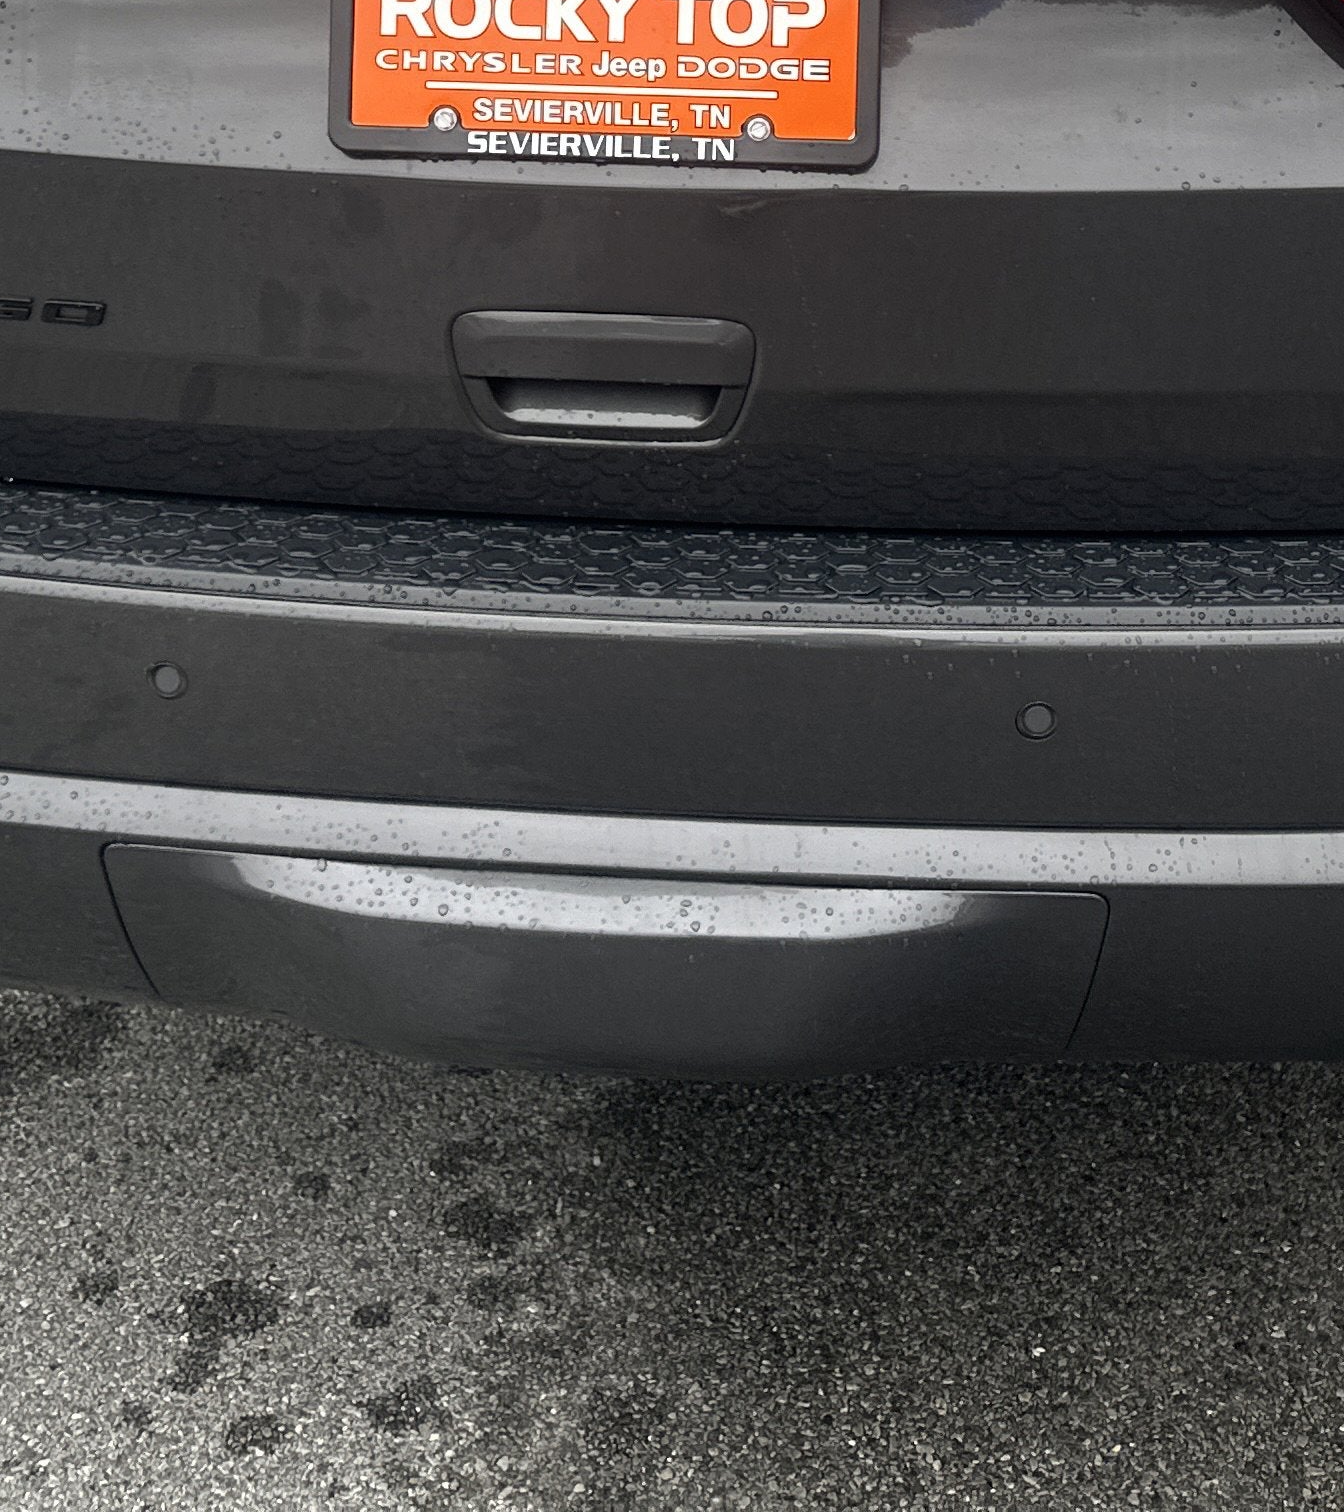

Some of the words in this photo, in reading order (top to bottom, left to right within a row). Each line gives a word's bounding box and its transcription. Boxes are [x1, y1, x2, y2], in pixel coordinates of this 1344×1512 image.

[375, 48, 584, 76] CHRYSLER
[591, 50, 668, 81] Jeep
[677, 55, 831, 82] DODGE
[472, 97, 680, 133] SEVIERVILLE,
[689, 104, 732, 130] TN
[467, 131, 681, 163] SEVIERVILLE,
[692, 137, 735, 162] TN
